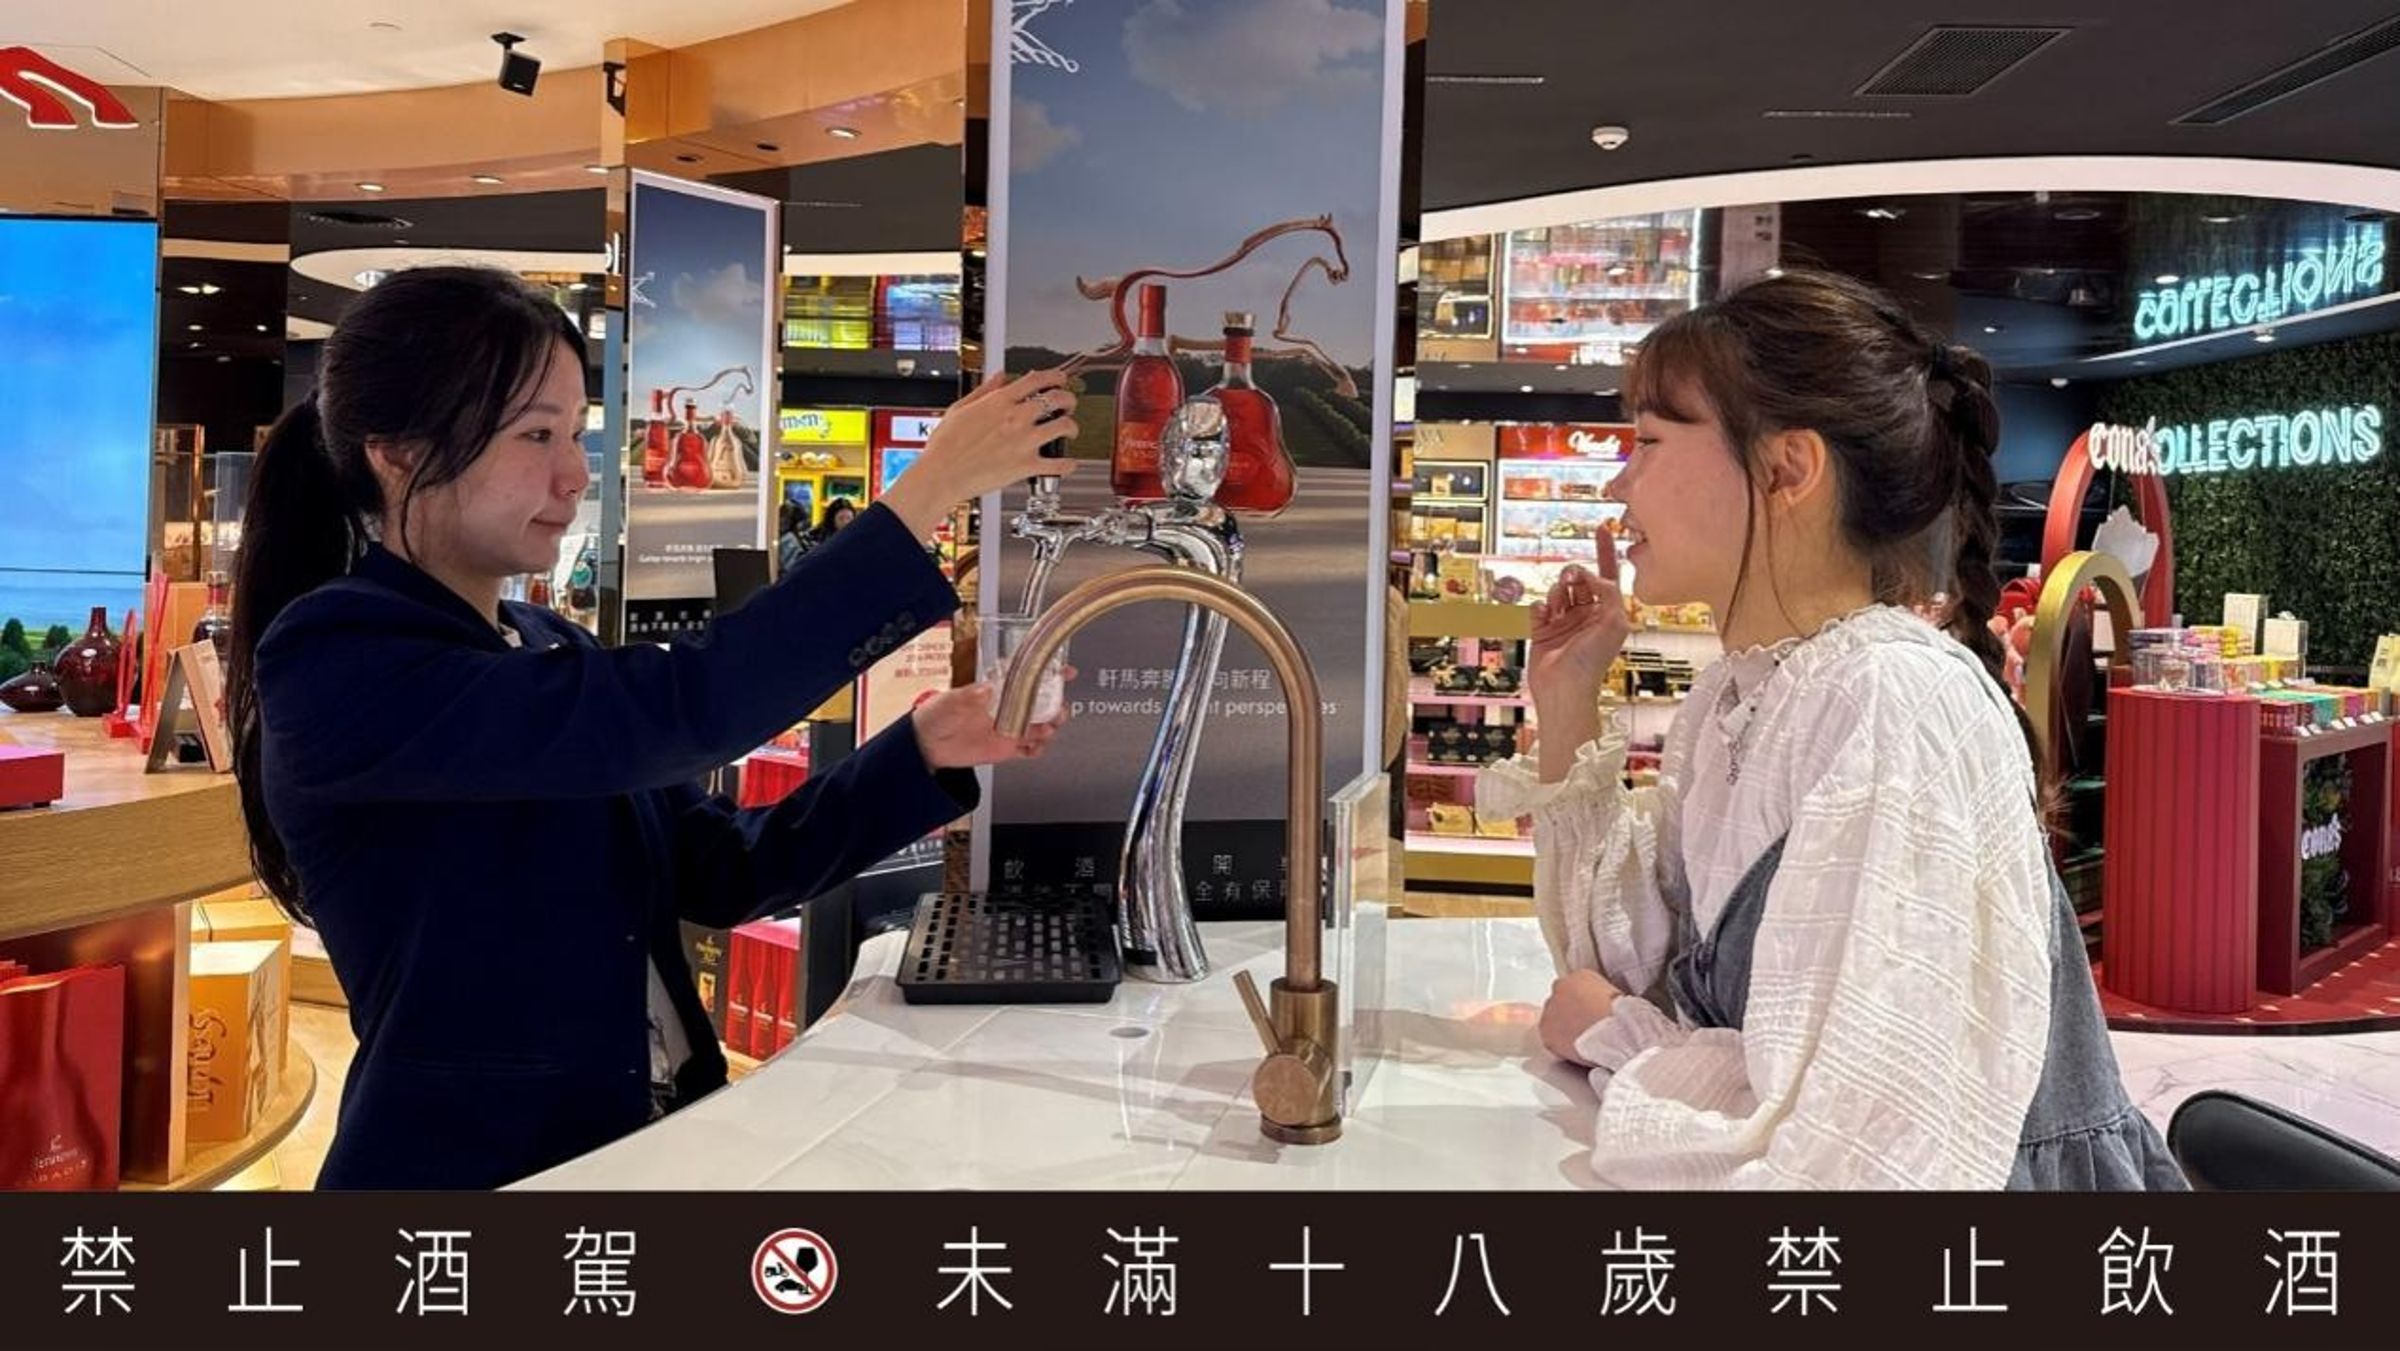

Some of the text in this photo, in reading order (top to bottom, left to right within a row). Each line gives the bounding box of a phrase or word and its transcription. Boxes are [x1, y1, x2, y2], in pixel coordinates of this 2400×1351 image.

[2155, 404, 2382, 476] OLLECTIONS
[1212, 668, 1273, 691] 向新程
[1088, 698, 1161, 714] towards
[1226, 700, 1337, 718] perspees
